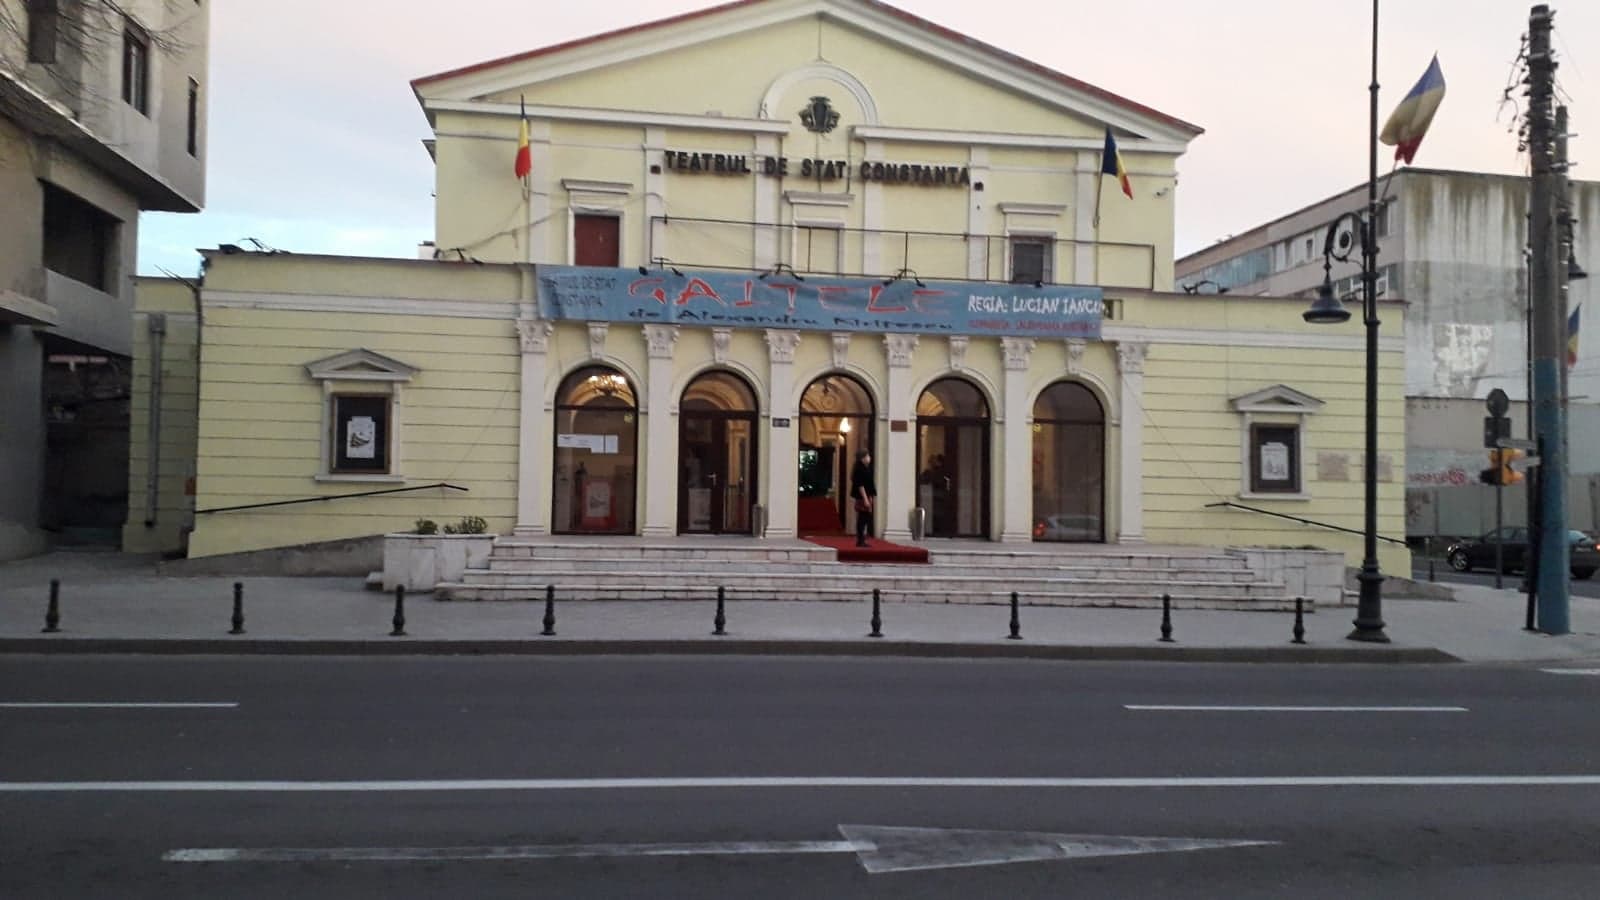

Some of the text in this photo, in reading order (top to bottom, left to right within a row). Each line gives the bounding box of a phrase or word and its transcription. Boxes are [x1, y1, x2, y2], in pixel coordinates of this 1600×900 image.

[664, 150, 970, 185] TEATRUL DE STAT CONSTANTA
[968, 295, 1008, 313] REGIA:
[1013, 296, 1059, 315] LUCIAN
